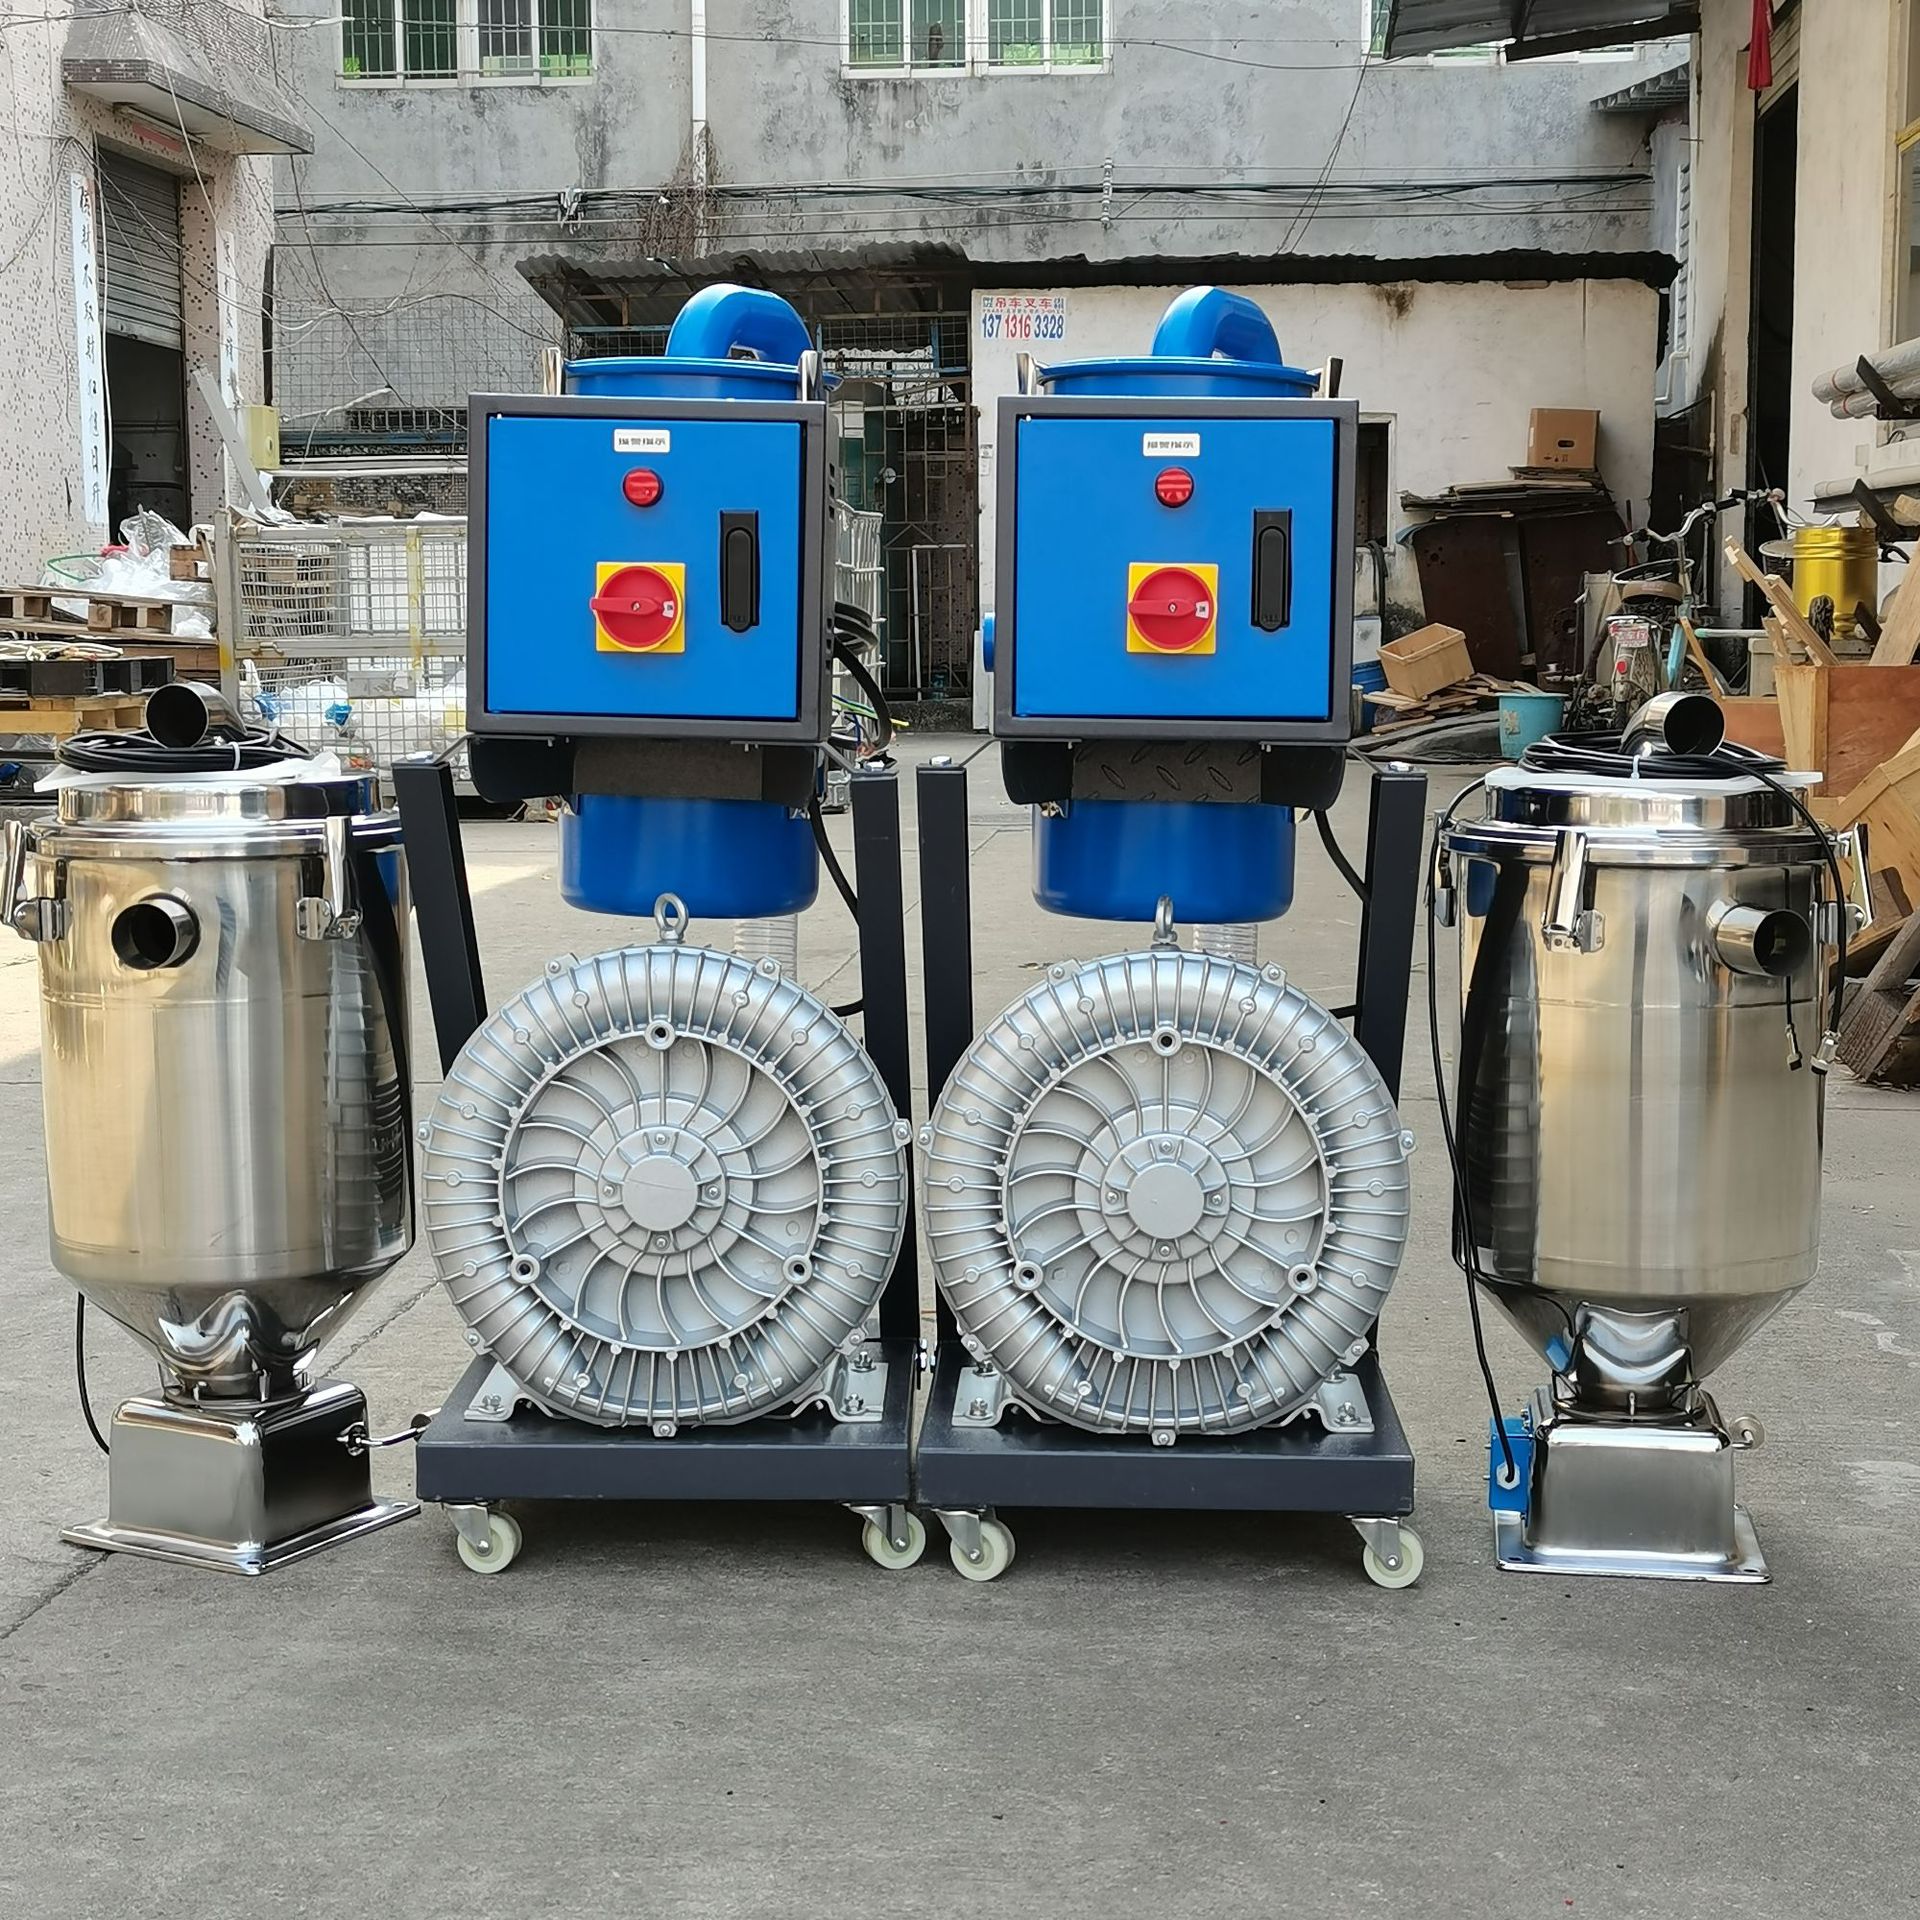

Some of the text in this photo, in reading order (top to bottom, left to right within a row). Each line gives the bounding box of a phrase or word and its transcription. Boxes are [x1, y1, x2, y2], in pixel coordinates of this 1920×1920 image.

[995, 297, 1053, 309] 吊车叉车
[982, 313, 1064, 339] 137 1316 3328
